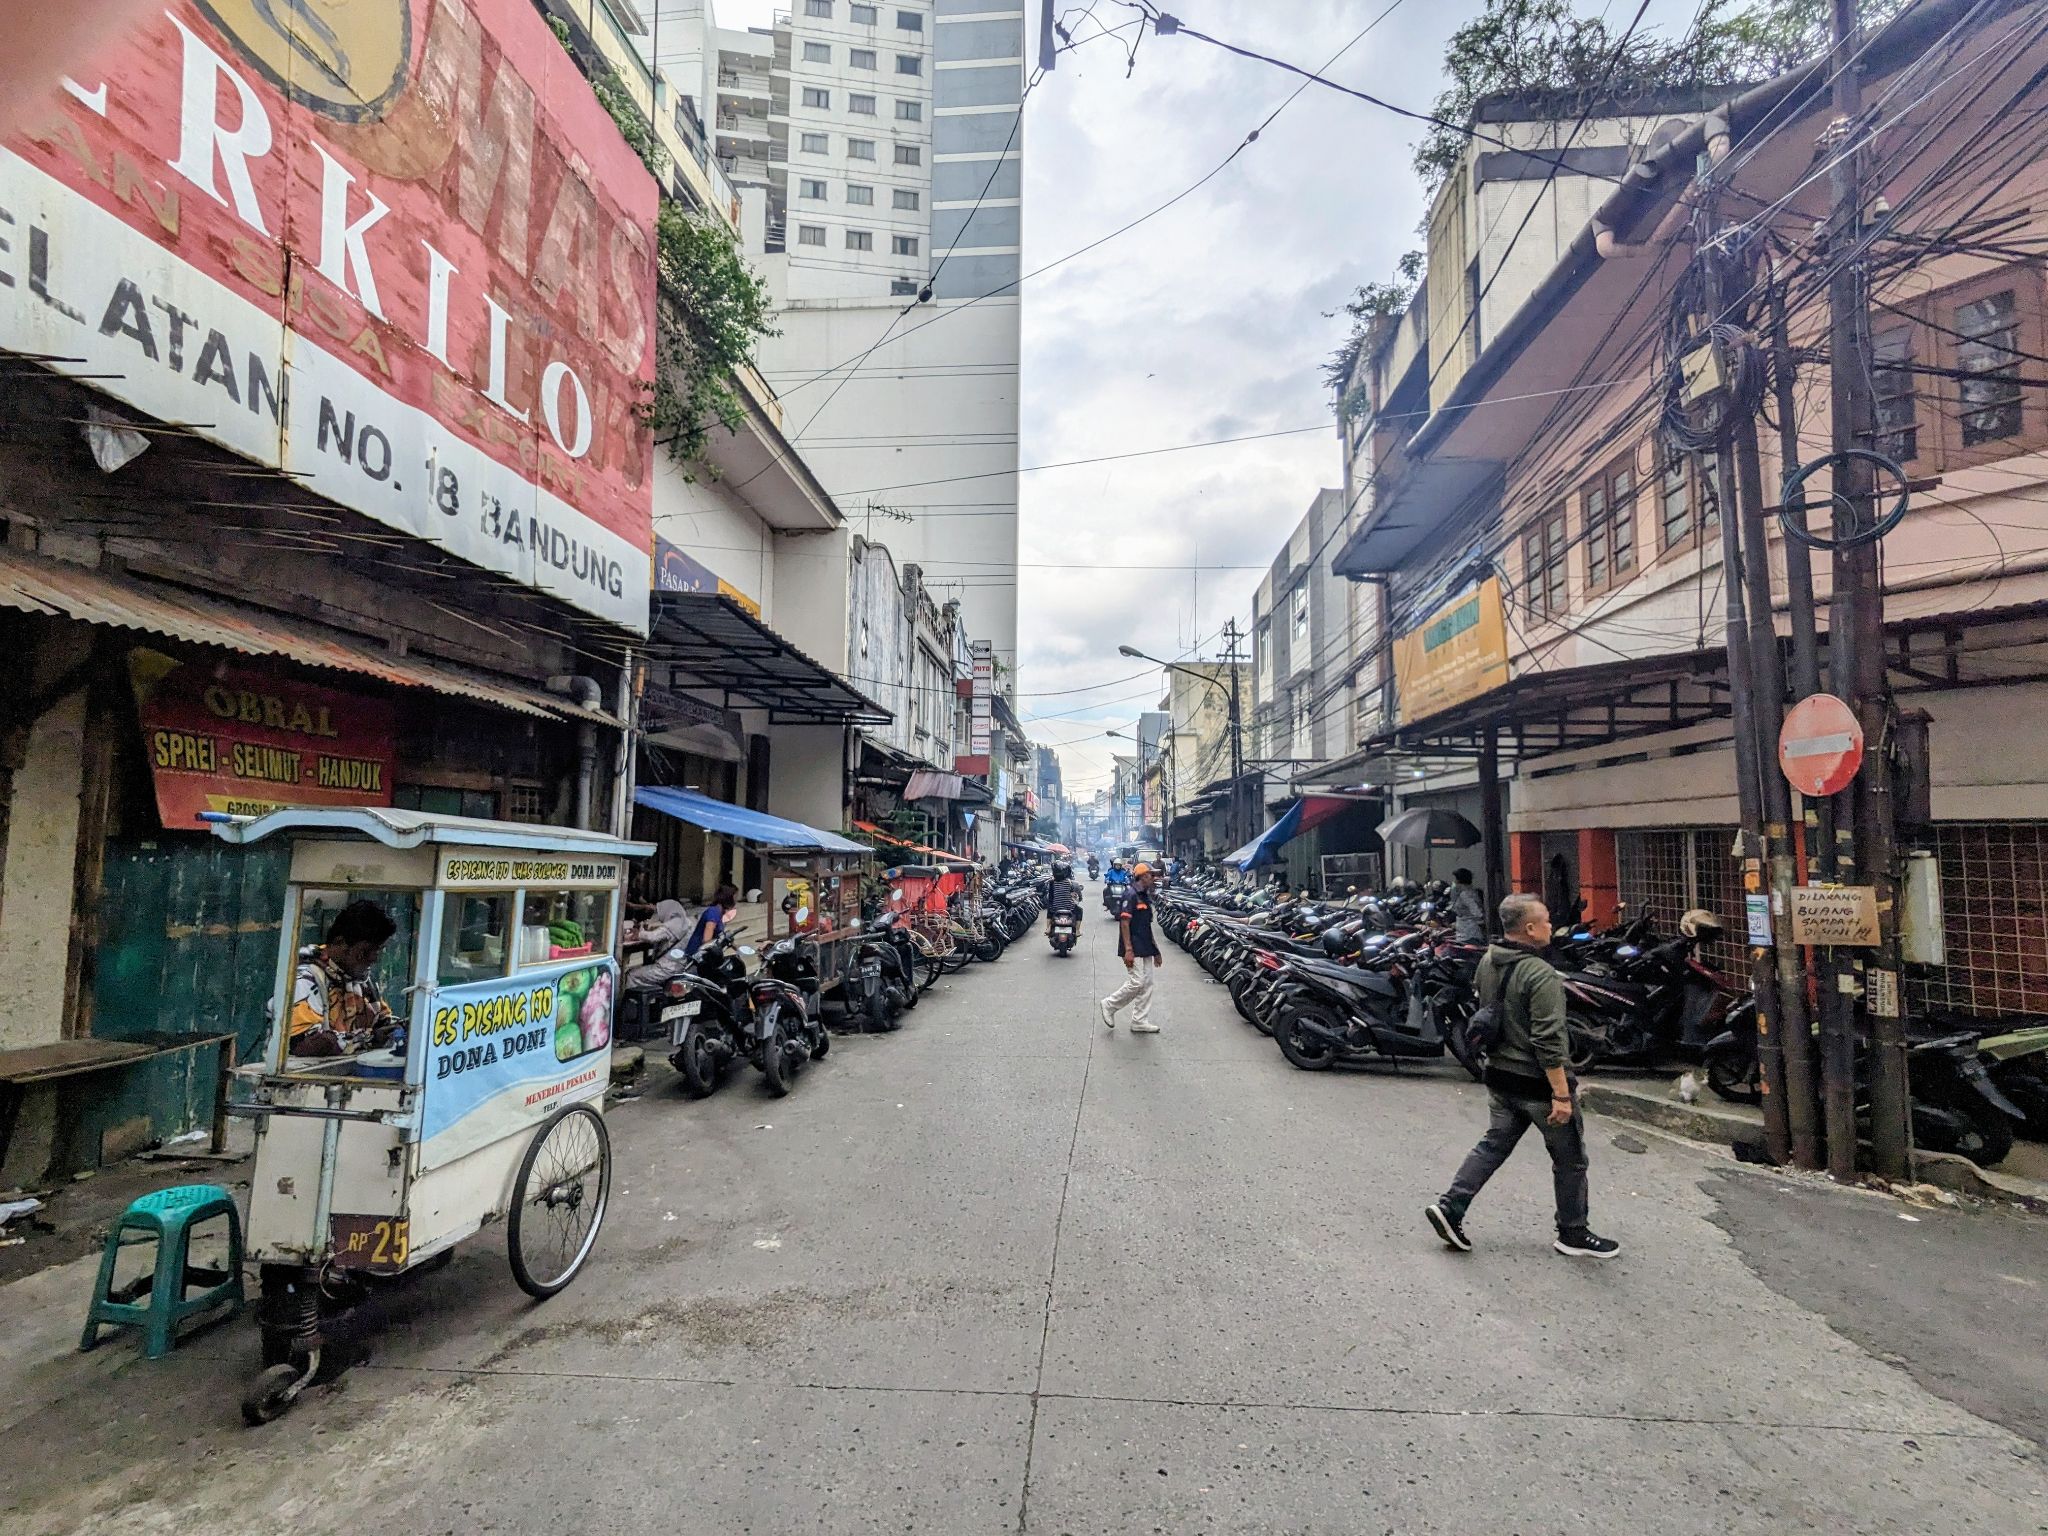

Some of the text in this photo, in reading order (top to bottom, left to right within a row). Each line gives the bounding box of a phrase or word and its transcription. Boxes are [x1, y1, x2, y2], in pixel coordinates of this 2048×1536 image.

[58, 9, 592, 459] RKILO
[317, 396, 402, 492] NO.
[425, 447, 459, 517] 18
[480, 490, 624, 600] BANDUNG
[203, 686, 339, 738] OBRAL
[154, 731, 217, 772] SPREI
[232, 743, 300, 783] SELIMUT
[318, 757, 382, 791] HANDUK
[447, 860, 461, 880] ES
[461, 861, 495, 880] PISANG
[496, 862, 510, 880] IJO
[571, 865, 594, 879] DONA
[596, 866, 616, 879] DONI
[1797, 906, 1854, 916] BUANG
[432, 986, 554, 1048] ES PISANG IJO
[1867, 968, 1878, 1014] LABEL
[437, 1027, 548, 1081] DONA DONI
[524, 1069, 598, 1107] MENERIMA PESANAN
[371, 1221, 409, 1265] 25
